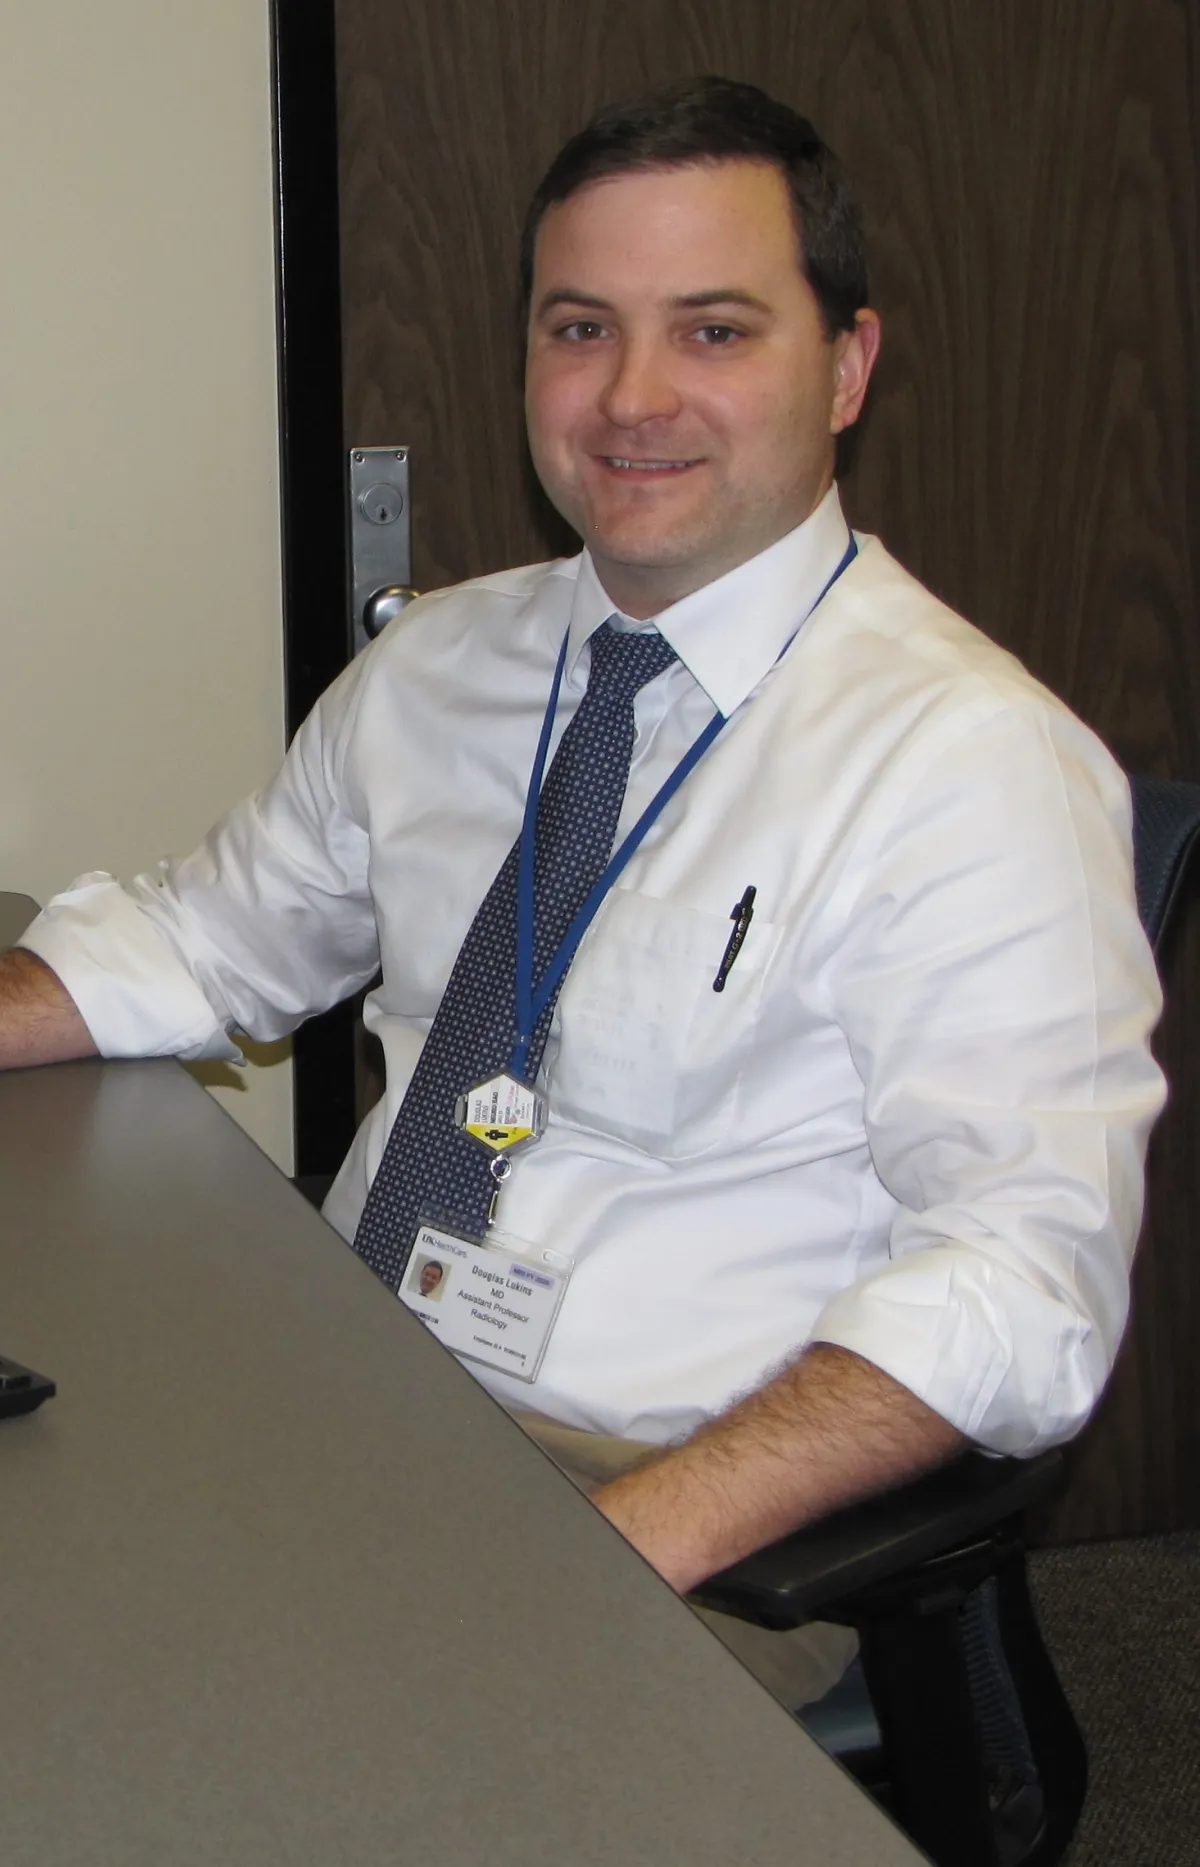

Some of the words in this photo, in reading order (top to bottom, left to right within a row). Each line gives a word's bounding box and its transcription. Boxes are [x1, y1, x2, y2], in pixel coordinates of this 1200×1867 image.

[471, 1264, 505, 1286] Douglas
[505, 1278, 534, 1297] Lukins
[490, 1287, 505, 1299] MD
[456, 1289, 492, 1311] Assistant
[492, 1301, 529, 1324] Professor
[470, 1308, 508, 1331] Radiology
